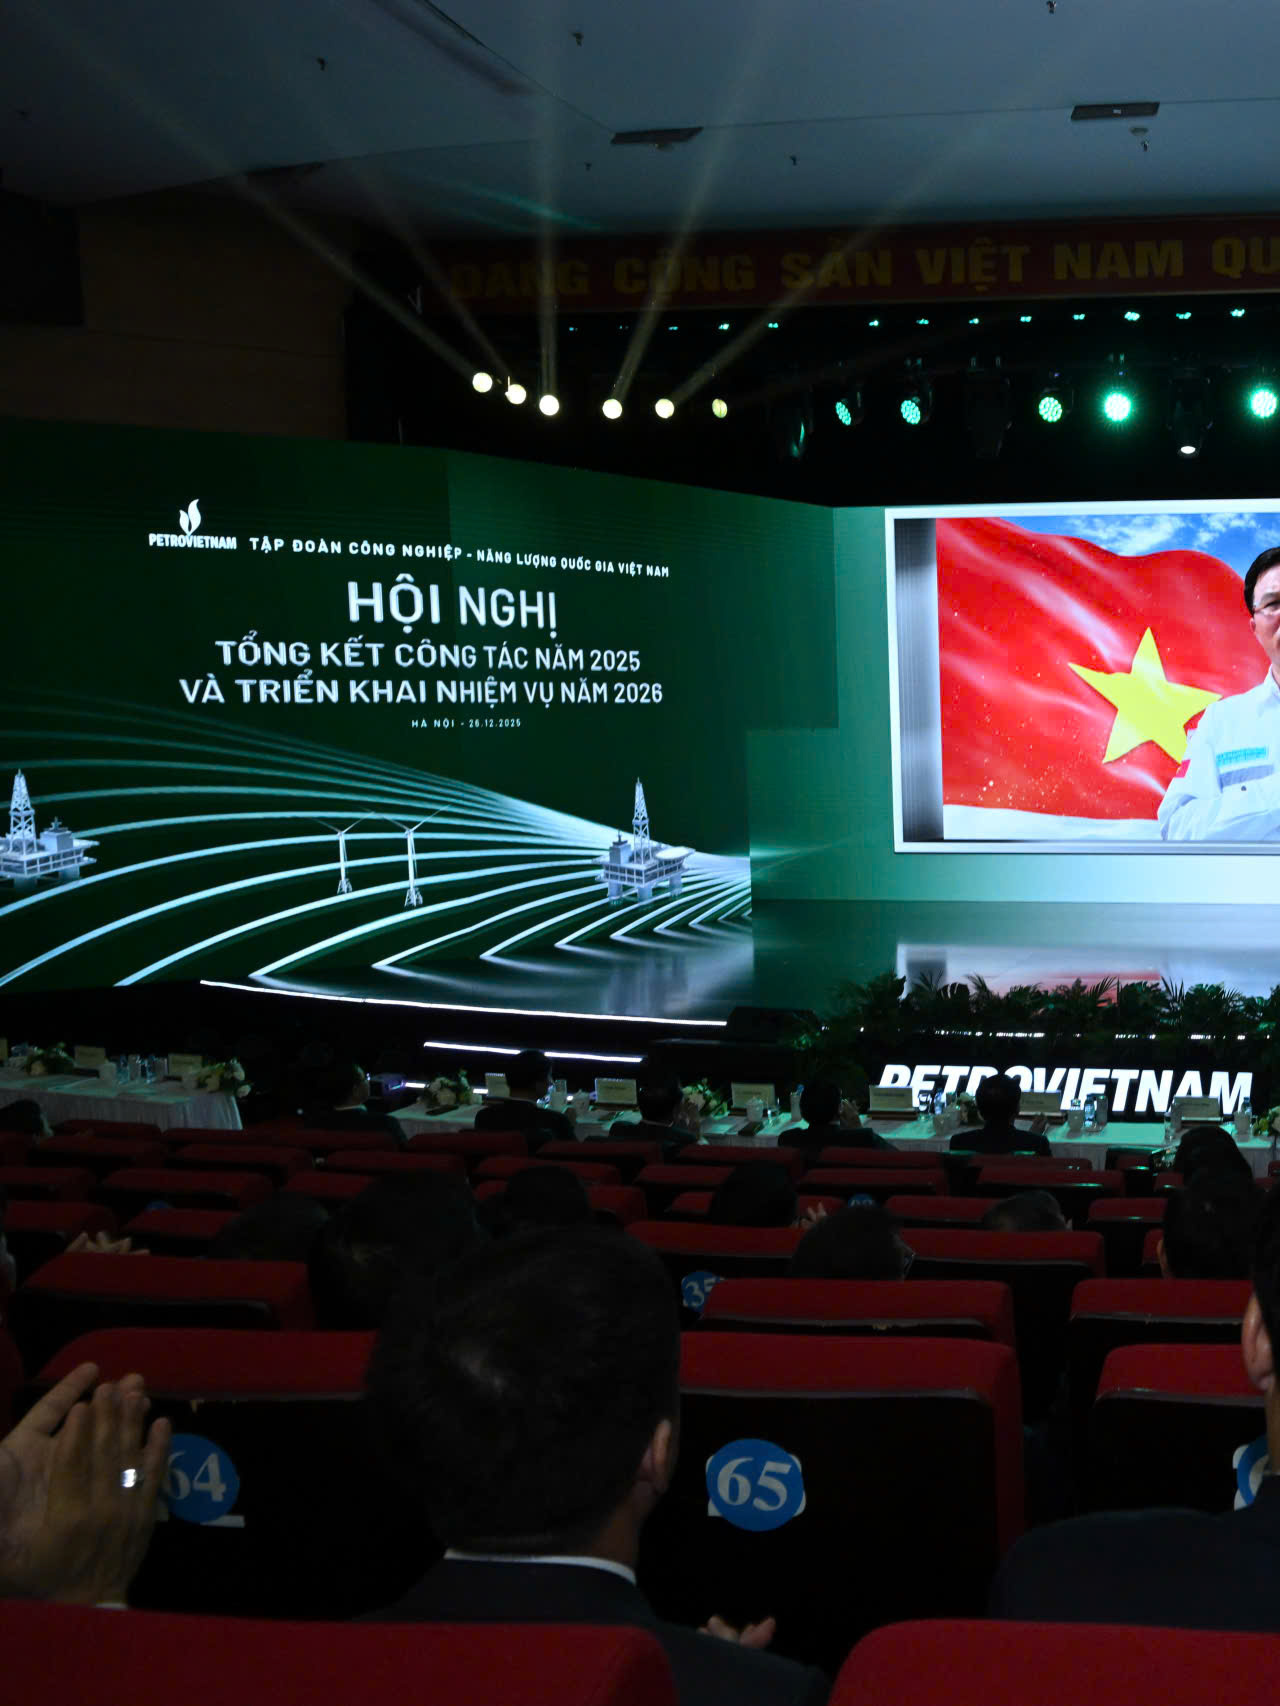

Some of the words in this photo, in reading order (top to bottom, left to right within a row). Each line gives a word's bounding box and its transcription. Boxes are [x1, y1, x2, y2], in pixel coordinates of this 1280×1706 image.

[914, 237, 1030, 293] VIỆT
[1053, 239, 1184, 280] NAM
[148, 532, 237, 550] PETROVIETNAM
[249, 535, 284, 556] TẬP
[292, 537, 342, 555] ĐOÀN
[348, 538, 396, 557] CÔNG
[401, 543, 462, 563] NGHIỆP
[476, 548, 512, 564] NĂNG
[516, 552, 557, 570] LƯỢNG
[560, 554, 592, 572] QUỐC
[594, 560, 615, 573] GIA
[617, 561, 643, 577] VIỆT
[646, 564, 669, 578] NAM
[347, 573, 441, 634] HỘI
[458, 585, 557, 640] NGHỊ
[214, 629, 311, 668] TỔNG
[320, 633, 385, 668] KẾT
[395, 637, 477, 669] CÔNG
[482, 640, 529, 671] TÁC
[535, 642, 584, 672] NĂM
[589, 649, 641, 673] 2025
[178, 673, 225, 704] VÀ
[234, 668, 339, 705] TRIỂN
[349, 680, 427, 704] KHAI
[436, 676, 517, 710] NHIỆM
[523, 681, 555, 710] VỤ
[560, 677, 608, 704] NĂM
[613, 682, 663, 704] 2026
[411, 717, 428, 728] HÀ
[163, 1450, 226, 1502] 64
[717, 1456, 791, 1511] 65
